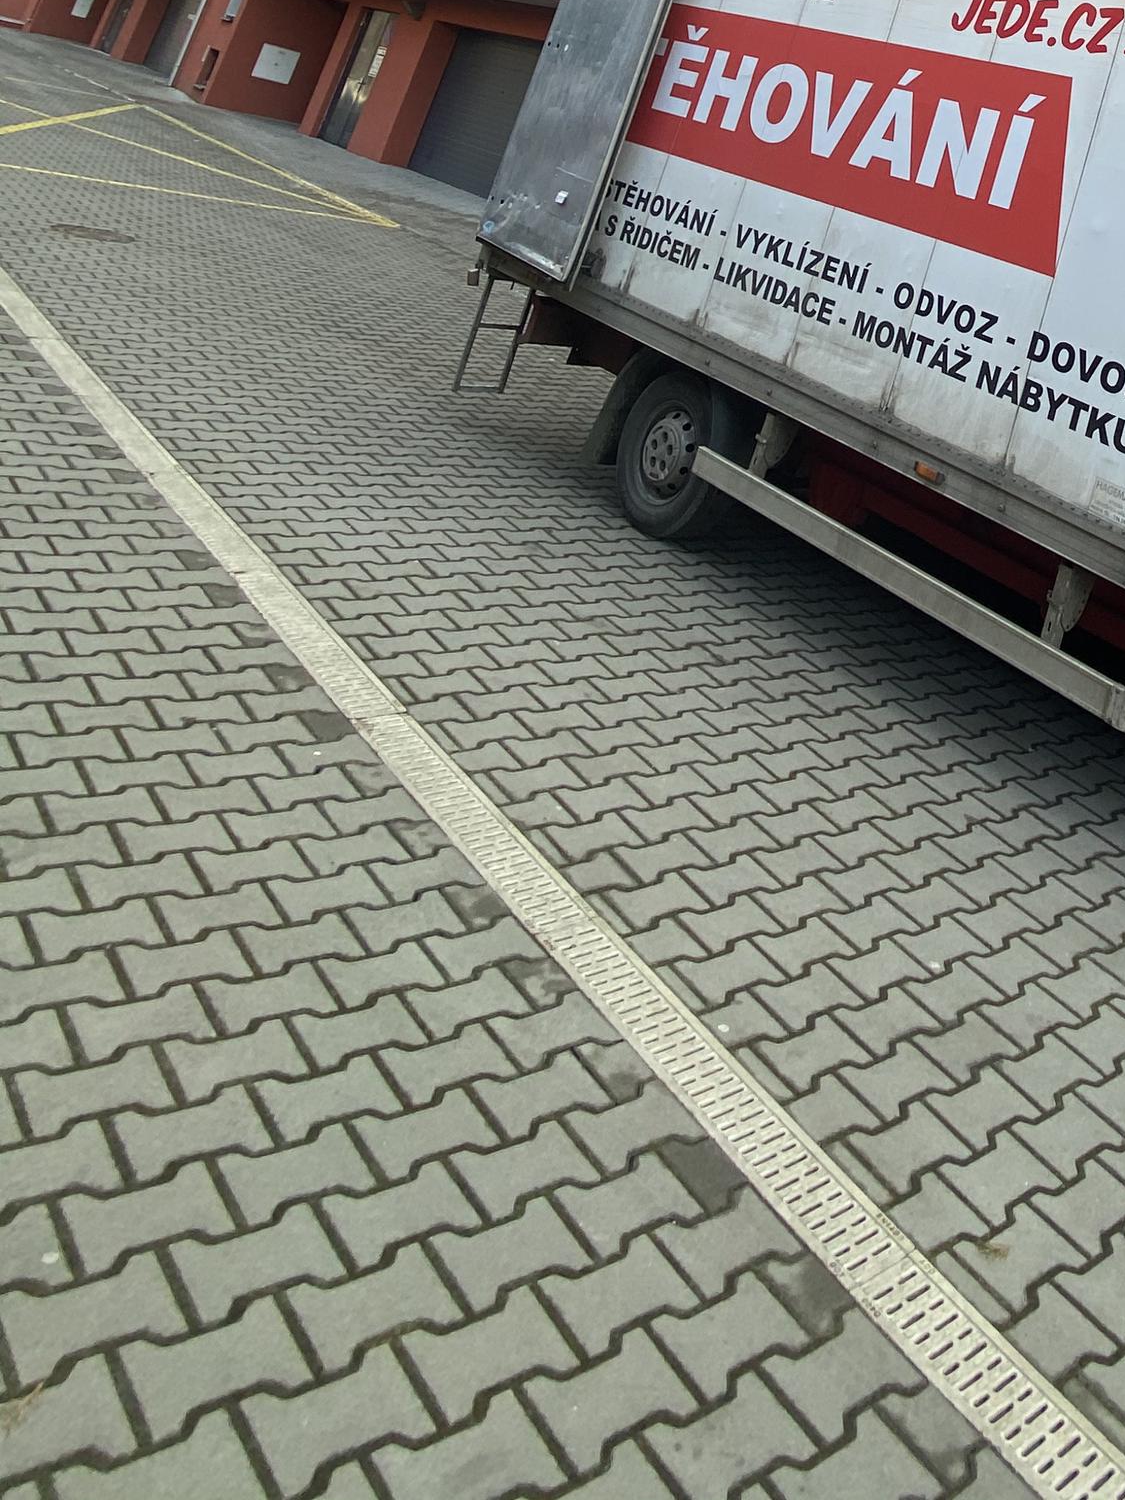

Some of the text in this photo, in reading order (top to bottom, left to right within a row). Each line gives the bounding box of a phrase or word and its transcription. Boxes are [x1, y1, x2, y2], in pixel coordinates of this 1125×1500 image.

[651, 24, 1046, 210] ĚHOVÁNÍ
[605, 215, 618, 236] S
[620, 216, 701, 271] ŘIDIČEM
[713, 257, 836, 326] LIKVIDACE
[852, 310, 972, 382] MONTÁŽ
[736, 224, 872, 294] VYKLÍZENÍ
[894, 282, 999, 344] ODVOZ
